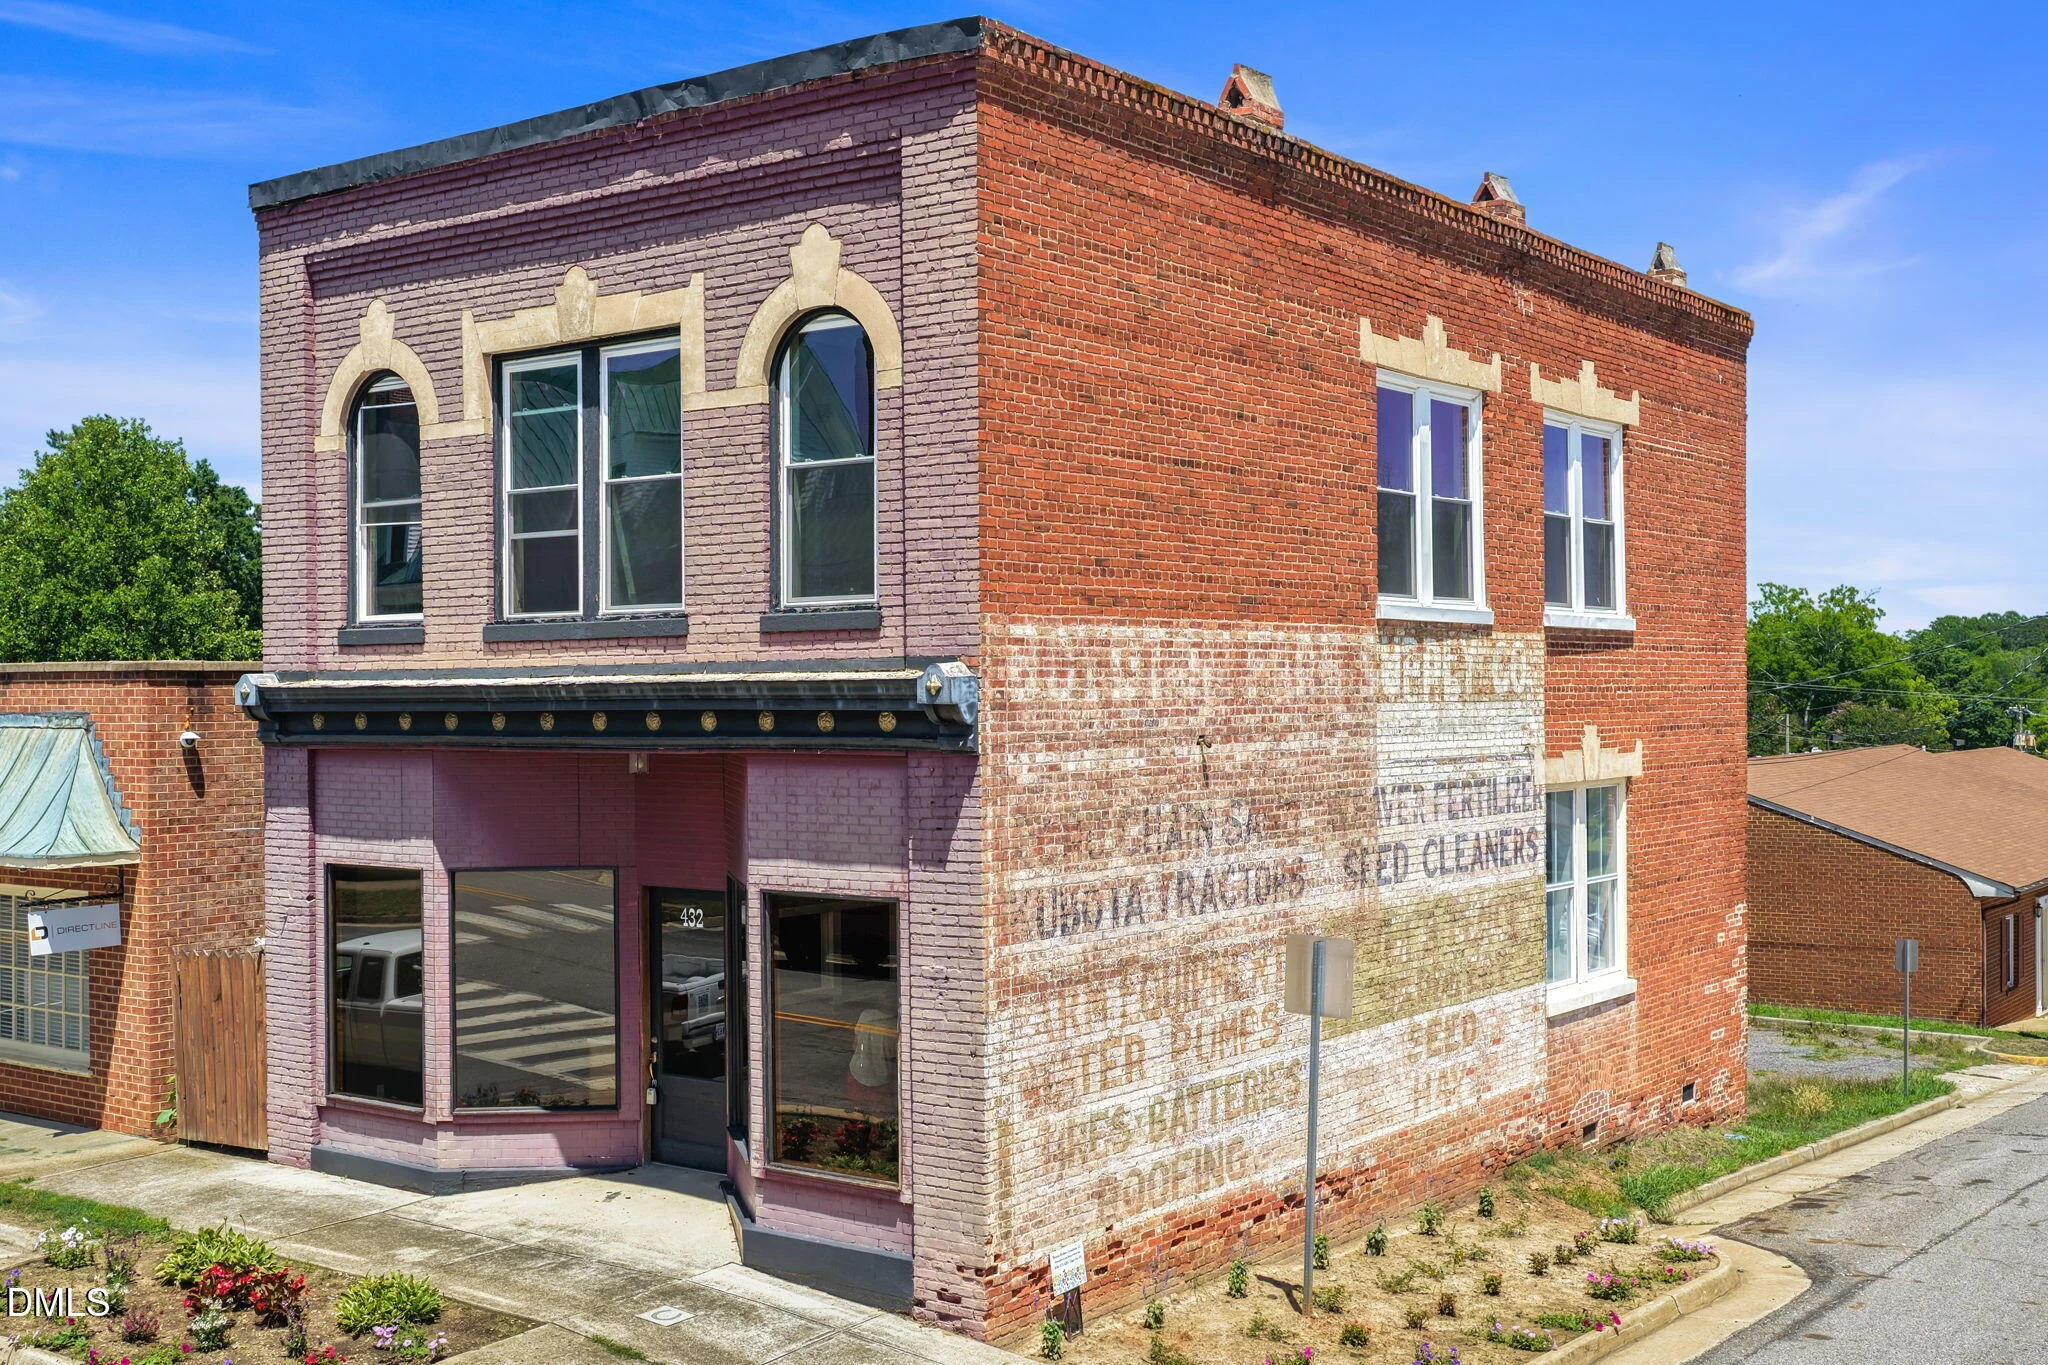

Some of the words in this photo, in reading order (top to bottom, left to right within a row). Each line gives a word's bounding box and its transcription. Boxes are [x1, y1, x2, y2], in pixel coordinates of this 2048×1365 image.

[1342, 839, 1408, 892] SEED
[1422, 822, 1538, 880] CLEANERS
[57, 921, 118, 935] DIRECTLINE
[680, 908, 704, 928] 432
[1013, 873, 1145, 945] UBOTA
